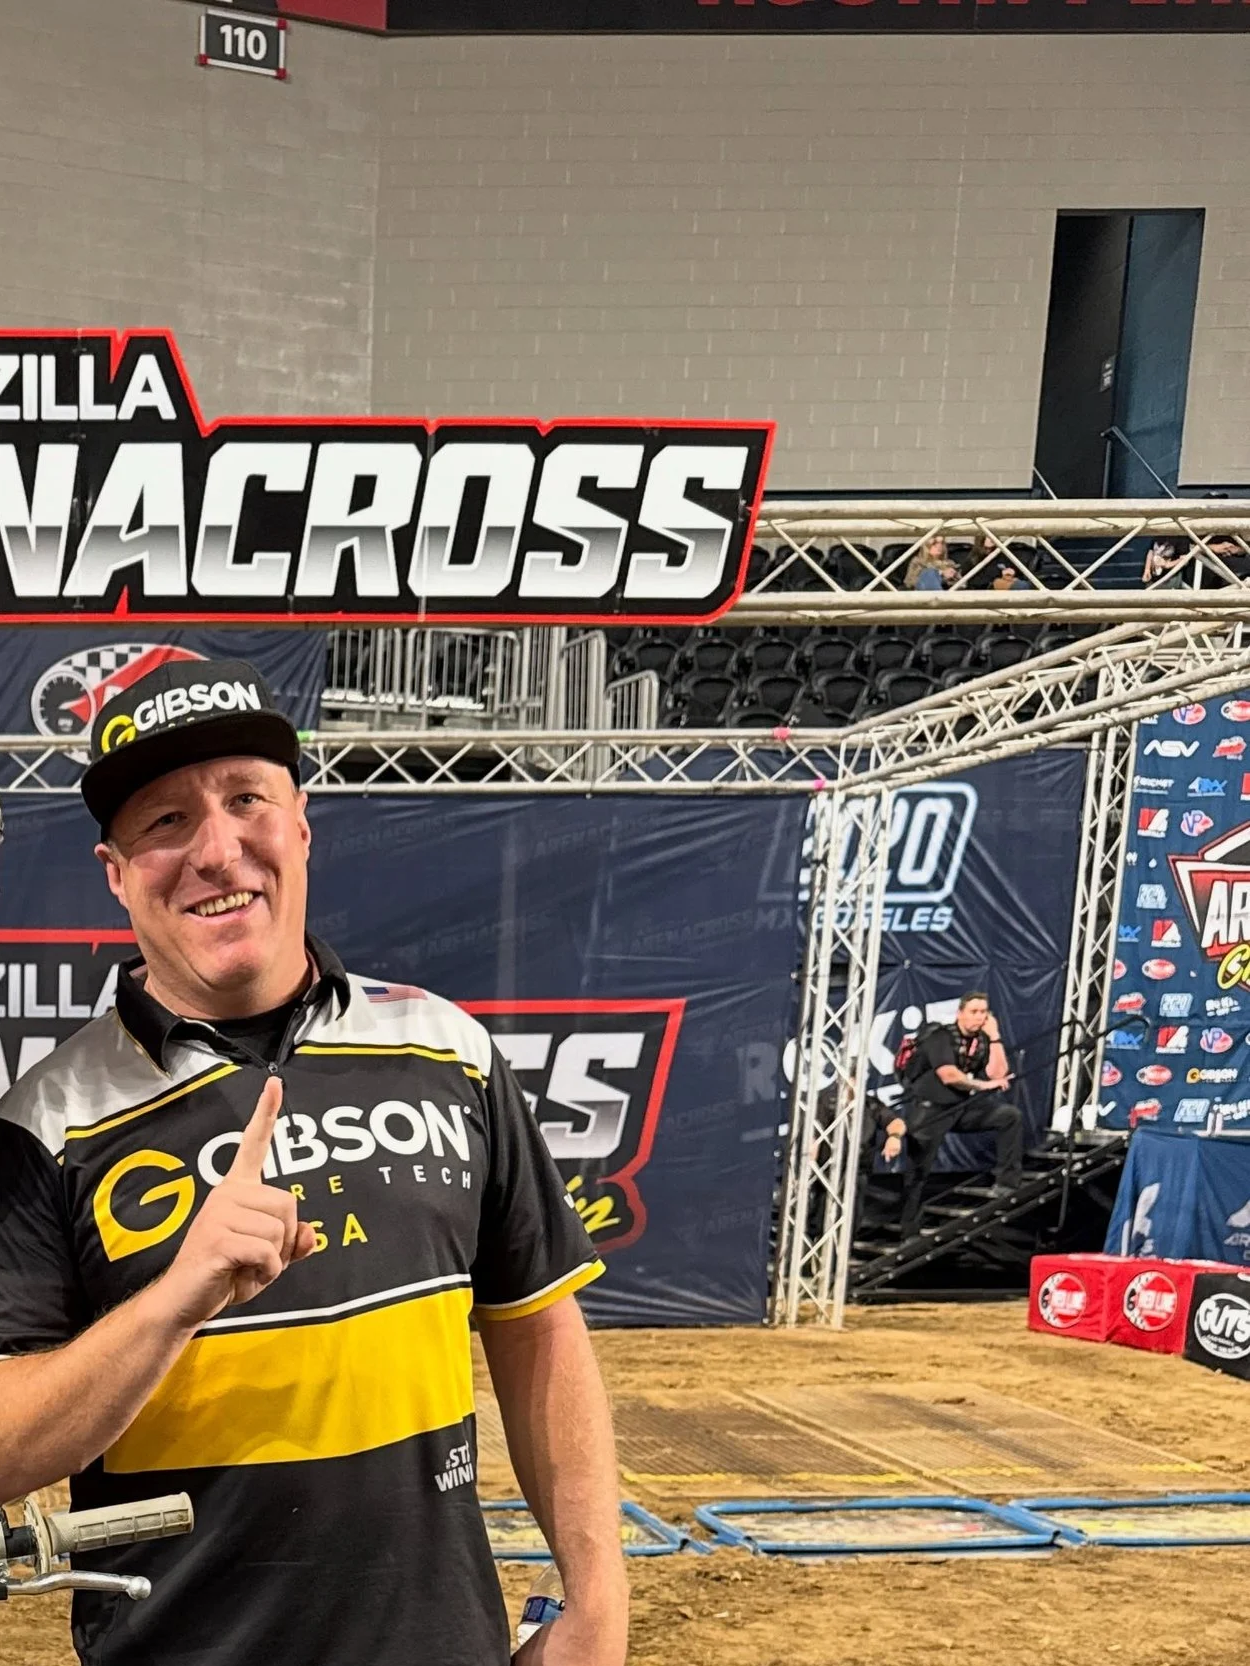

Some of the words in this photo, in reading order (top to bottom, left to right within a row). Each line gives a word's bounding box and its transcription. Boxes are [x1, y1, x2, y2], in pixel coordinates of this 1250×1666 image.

[220, 24, 267, 61] 110
[132, 681, 262, 733] GIBSON
[1143, 739, 1200, 758] ASV
[812, 905, 954, 932] GOGLES
[197, 1100, 471, 1187] GIBSON
[378, 1164, 472, 1190] TECH
[92, 1149, 196, 1263] G
[310, 1212, 369, 1254] SA
